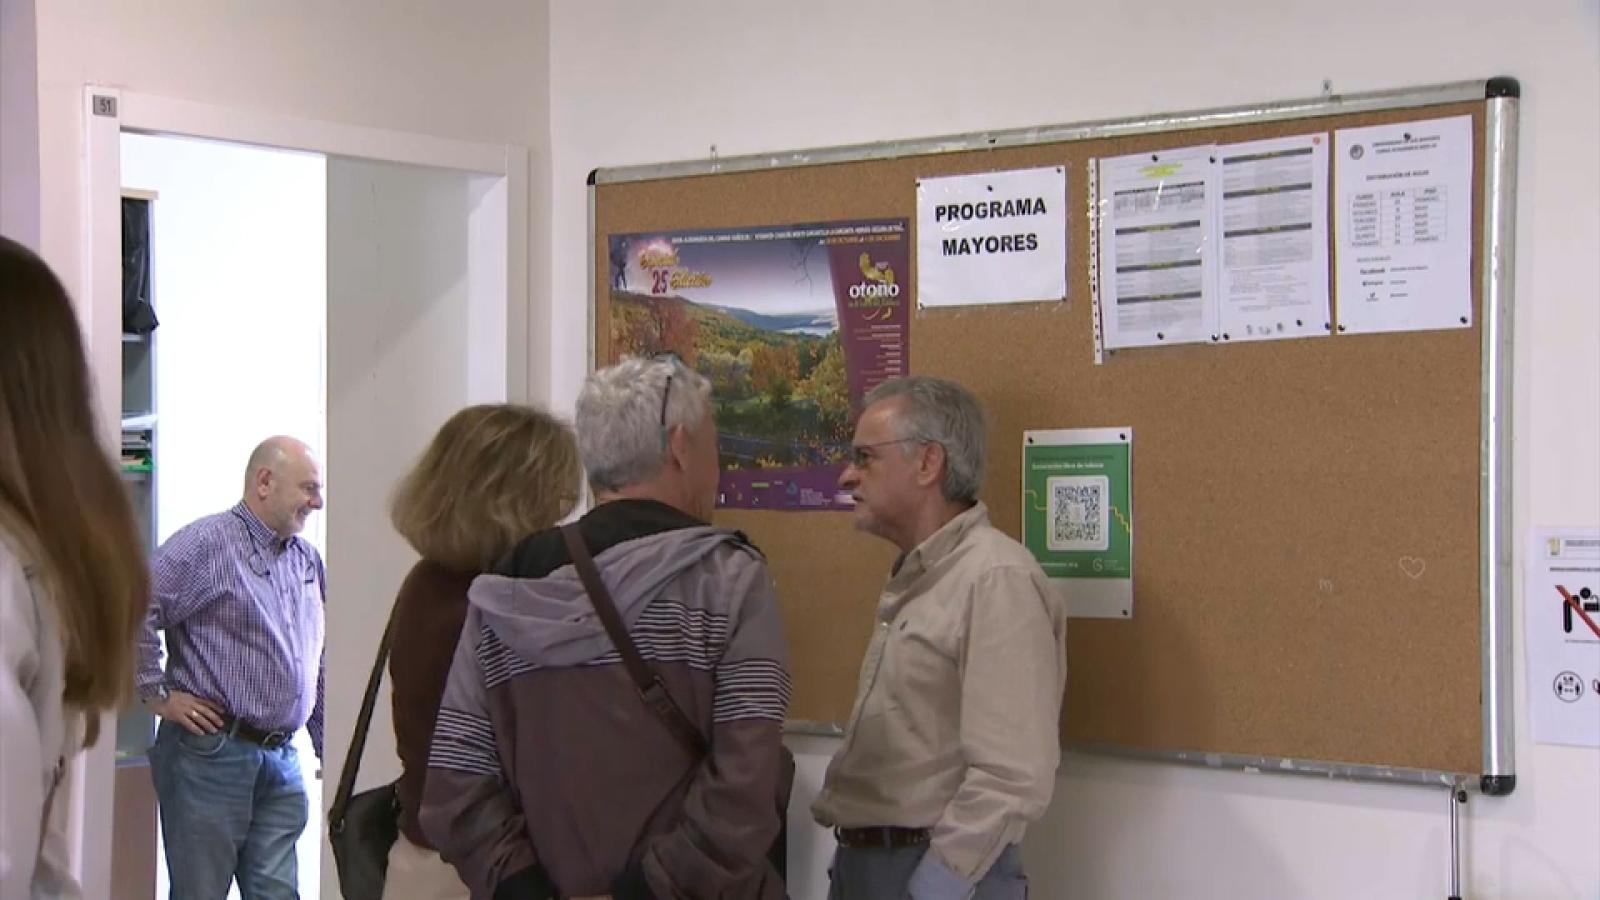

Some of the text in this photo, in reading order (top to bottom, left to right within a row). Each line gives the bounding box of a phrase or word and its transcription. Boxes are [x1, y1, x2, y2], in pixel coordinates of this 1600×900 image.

[100, 98, 110, 112] 51
[935, 197, 1046, 222] PROGRAMA
[942, 233, 1038, 256] MAYORES
[652, 269, 669, 294] 25
[849, 279, 900, 298] otoño
